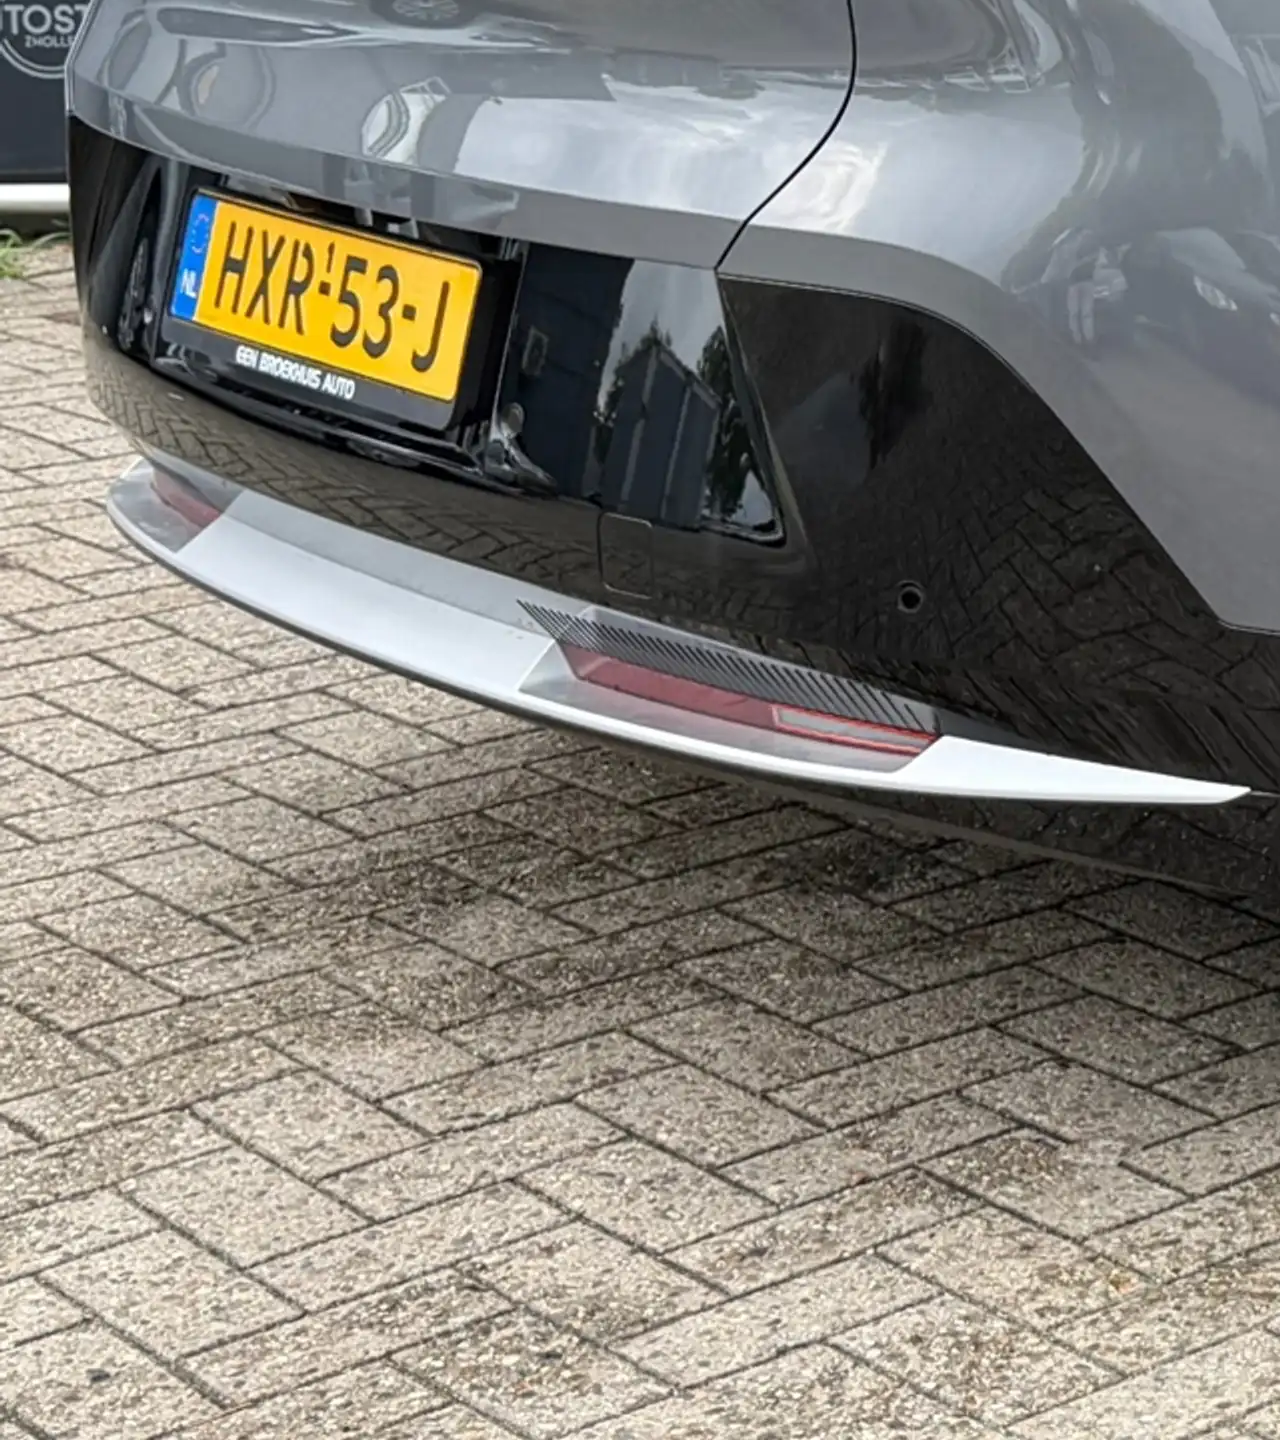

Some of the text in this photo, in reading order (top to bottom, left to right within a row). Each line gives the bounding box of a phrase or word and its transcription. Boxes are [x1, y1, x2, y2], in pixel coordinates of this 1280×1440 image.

[179, 269, 197, 299] NL
[213, 220, 451, 373] HXR-53-J
[321, 372, 356, 401] AUTO
